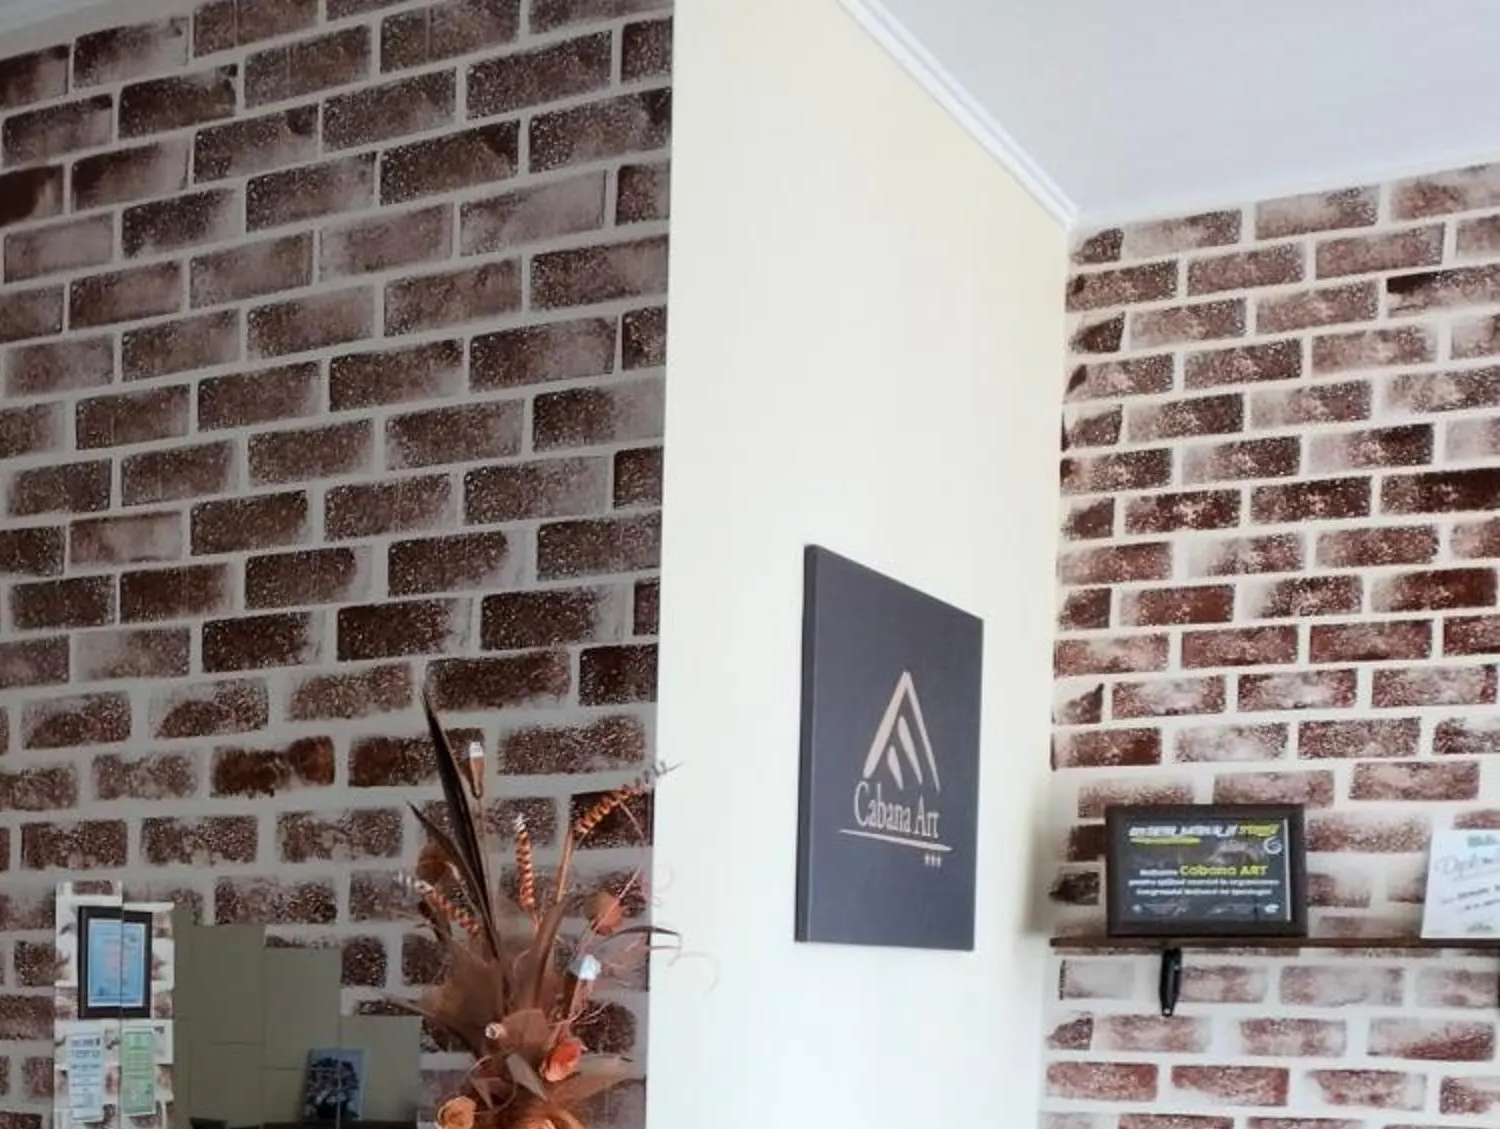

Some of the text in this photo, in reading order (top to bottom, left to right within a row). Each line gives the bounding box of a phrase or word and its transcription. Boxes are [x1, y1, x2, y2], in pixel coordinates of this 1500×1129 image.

[853, 780, 939, 839] Cabana Art
[1179, 864, 1236, 876] Cabana
[1240, 865, 1268, 876] ART
